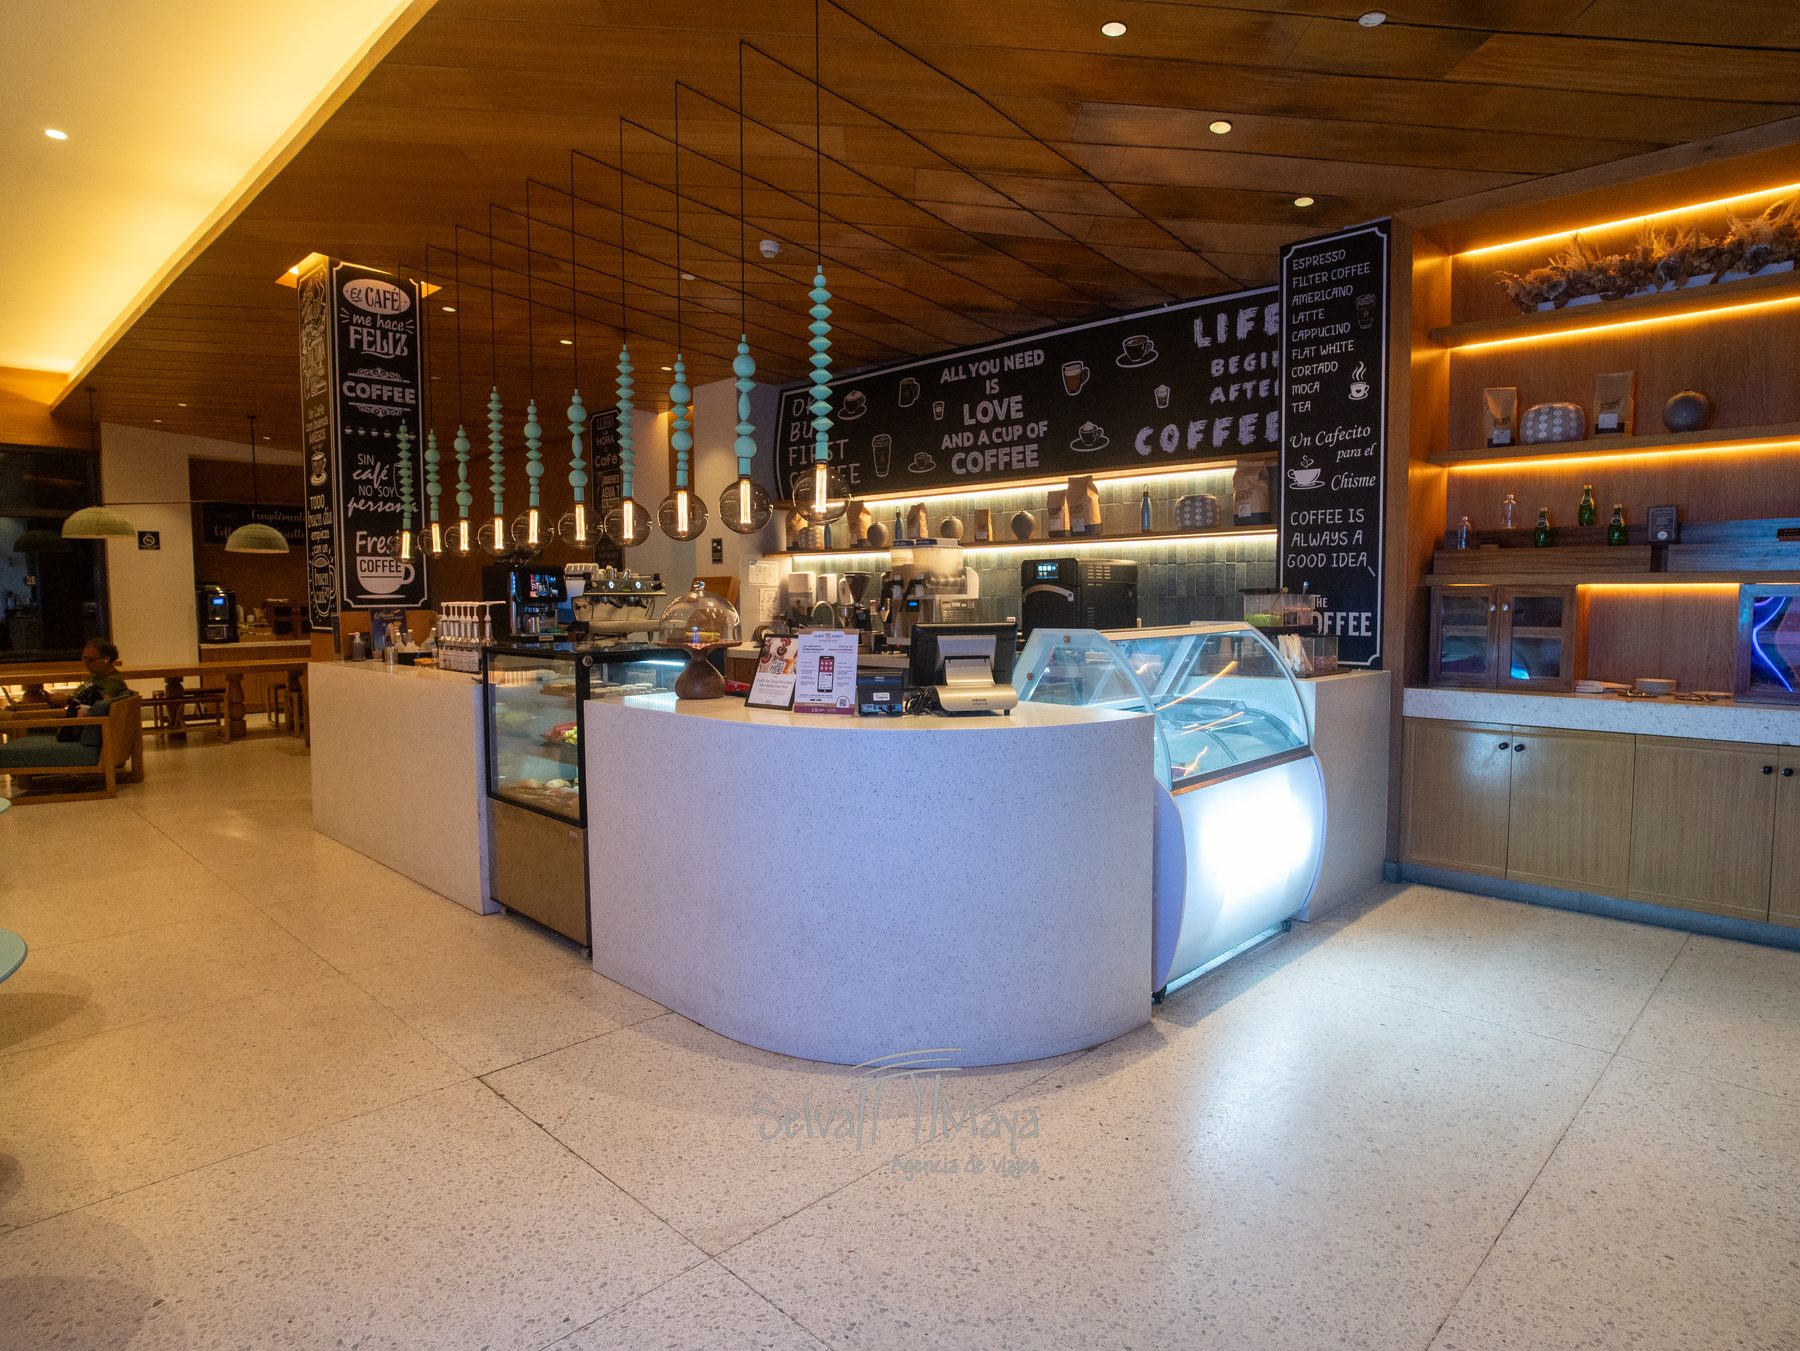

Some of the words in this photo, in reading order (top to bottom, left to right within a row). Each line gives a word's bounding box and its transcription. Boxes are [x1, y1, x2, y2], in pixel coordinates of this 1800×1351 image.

[1292, 250, 1346, 271] ESPRESSO
[1292, 271, 1328, 289] FILTER
[1330, 262, 1371, 280] COFFEE
[364, 287, 400, 311] CAFÉ
[1291, 285, 1354, 307] AMERICANO
[353, 314, 372, 326] me
[376, 314, 405, 331] hace
[1193, 303, 1279, 348] LIFE
[1292, 308, 1325, 325] LATTE
[349, 327, 409, 357] FELIZ
[1291, 322, 1351, 343] CAPPUCINO
[1292, 345, 1317, 360] FLAT
[1319, 339, 1355, 356] WHITE
[940, 367, 968, 384] ALL
[968, 360, 1001, 377] YOU
[1003, 350, 1045, 371] NEED
[1211, 351, 1279, 377] BEGIN
[1291, 361, 1339, 378] CORTADO
[342, 380, 416, 404] COFFEE
[985, 378, 1000, 395] IS
[1291, 381, 1320, 396] MOCA
[963, 395, 1024, 425] LOVE
[1292, 400, 1311, 414] TEA
[789, 420, 812, 442] BU
[941, 434, 973, 450] AND
[977, 431, 990, 446] A
[991, 425, 1021, 443] CUP
[1026, 421, 1048, 438] OF
[1134, 411, 1279, 456] COFFEE
[1290, 434, 1312, 448] Un
[1315, 425, 1371, 446] Cafecito
[358, 453, 374, 466] SIN
[951, 444, 1039, 475] COFFEE
[1336, 449, 1362, 463] para
[1364, 443, 1377, 456] el
[352, 461, 389, 489] café
[1331, 473, 1377, 492] Chisme
[358, 485, 373, 496] NO
[377, 486, 395, 498] SOY
[1290, 508, 1343, 525] COFFEE
[1347, 508, 1365, 523] IS
[356, 529, 401, 554] Fres
[1291, 532, 1348, 547] ALWAYS
[1352, 530, 1363, 545] A
[360, 559, 402, 573] COFFEE
[1287, 554, 1327, 568] GOOD
[1331, 552, 1367, 568] IDEA
[1312, 611, 1372, 636] OFFEE
